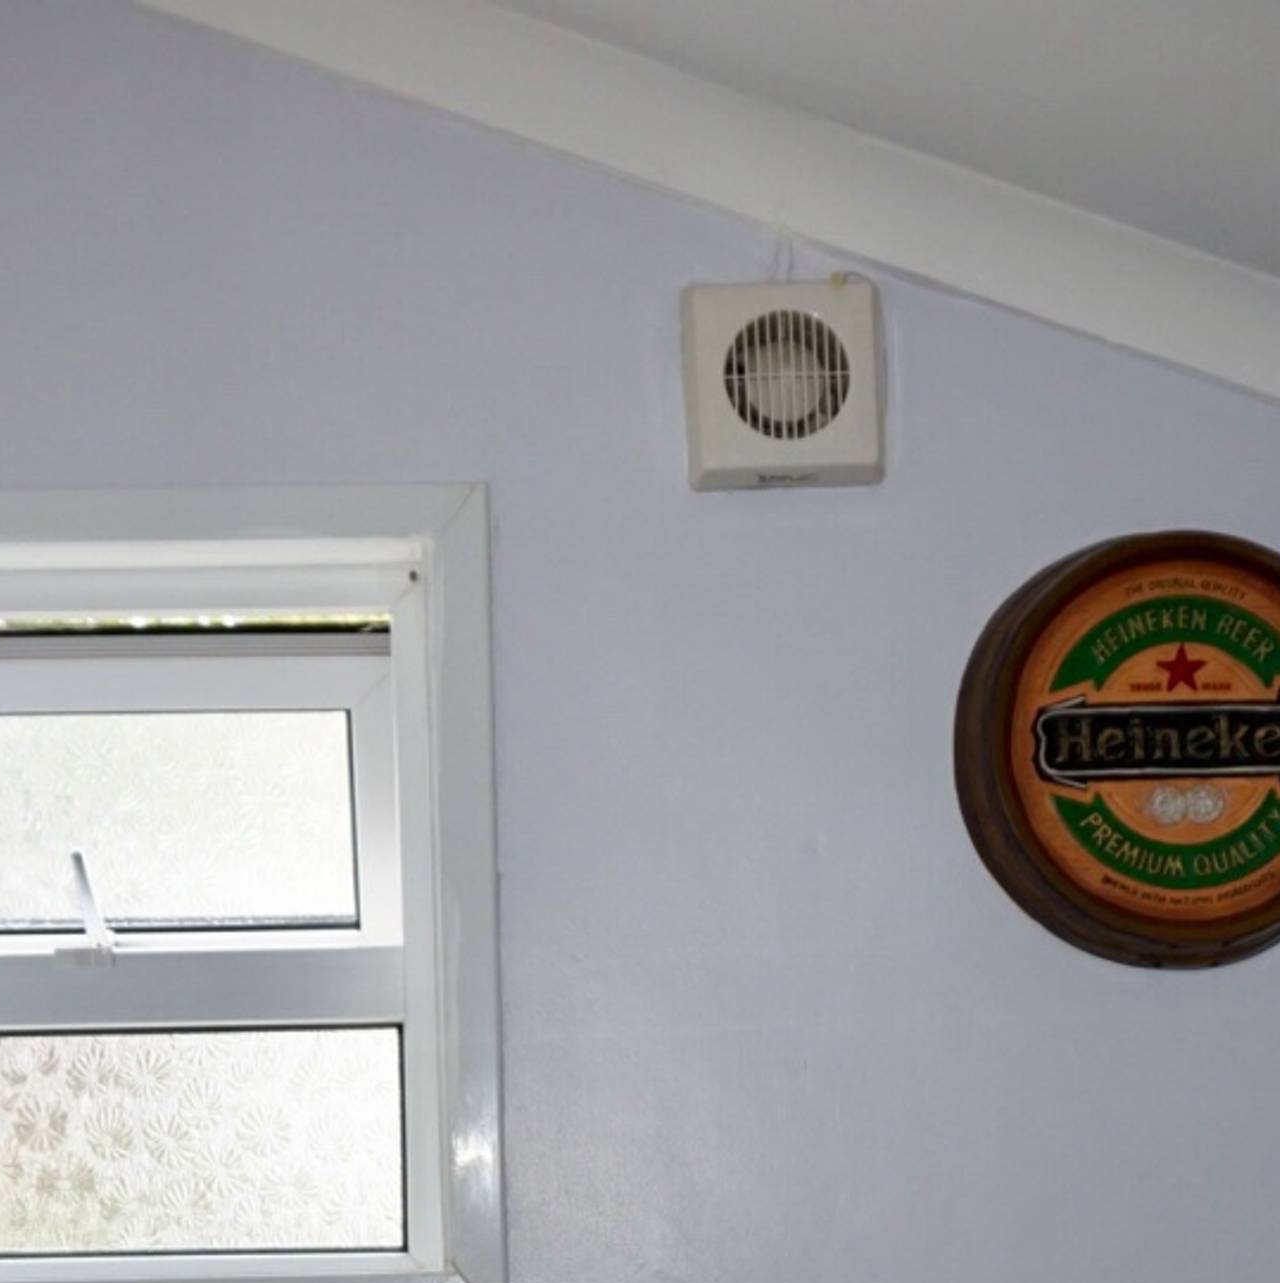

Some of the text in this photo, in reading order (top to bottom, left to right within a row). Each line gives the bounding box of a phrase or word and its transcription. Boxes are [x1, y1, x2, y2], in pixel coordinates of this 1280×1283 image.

[1091, 605, 1275, 665] HEINEKEN BEER
[1080, 811, 1185, 878] PREMIUM
